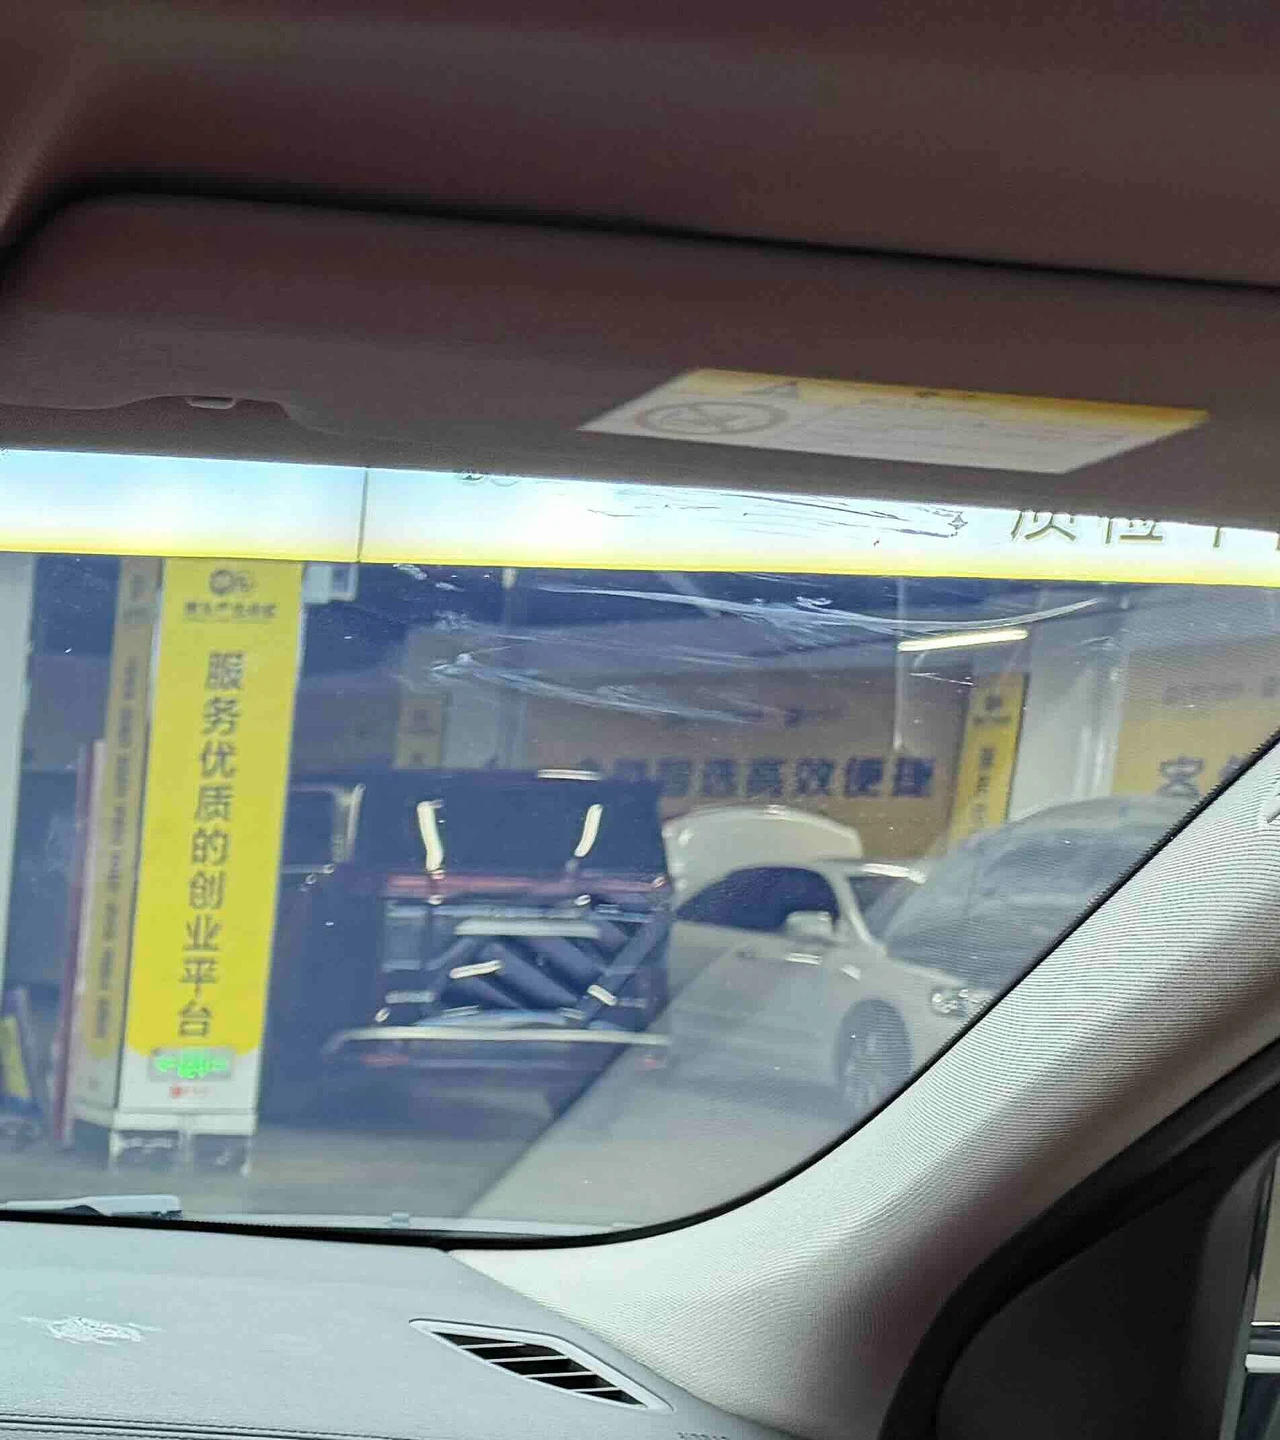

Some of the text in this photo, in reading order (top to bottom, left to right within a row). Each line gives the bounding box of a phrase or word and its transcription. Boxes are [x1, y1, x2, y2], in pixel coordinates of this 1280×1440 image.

[177, 650, 247, 1040] 服务优质的创业平台
